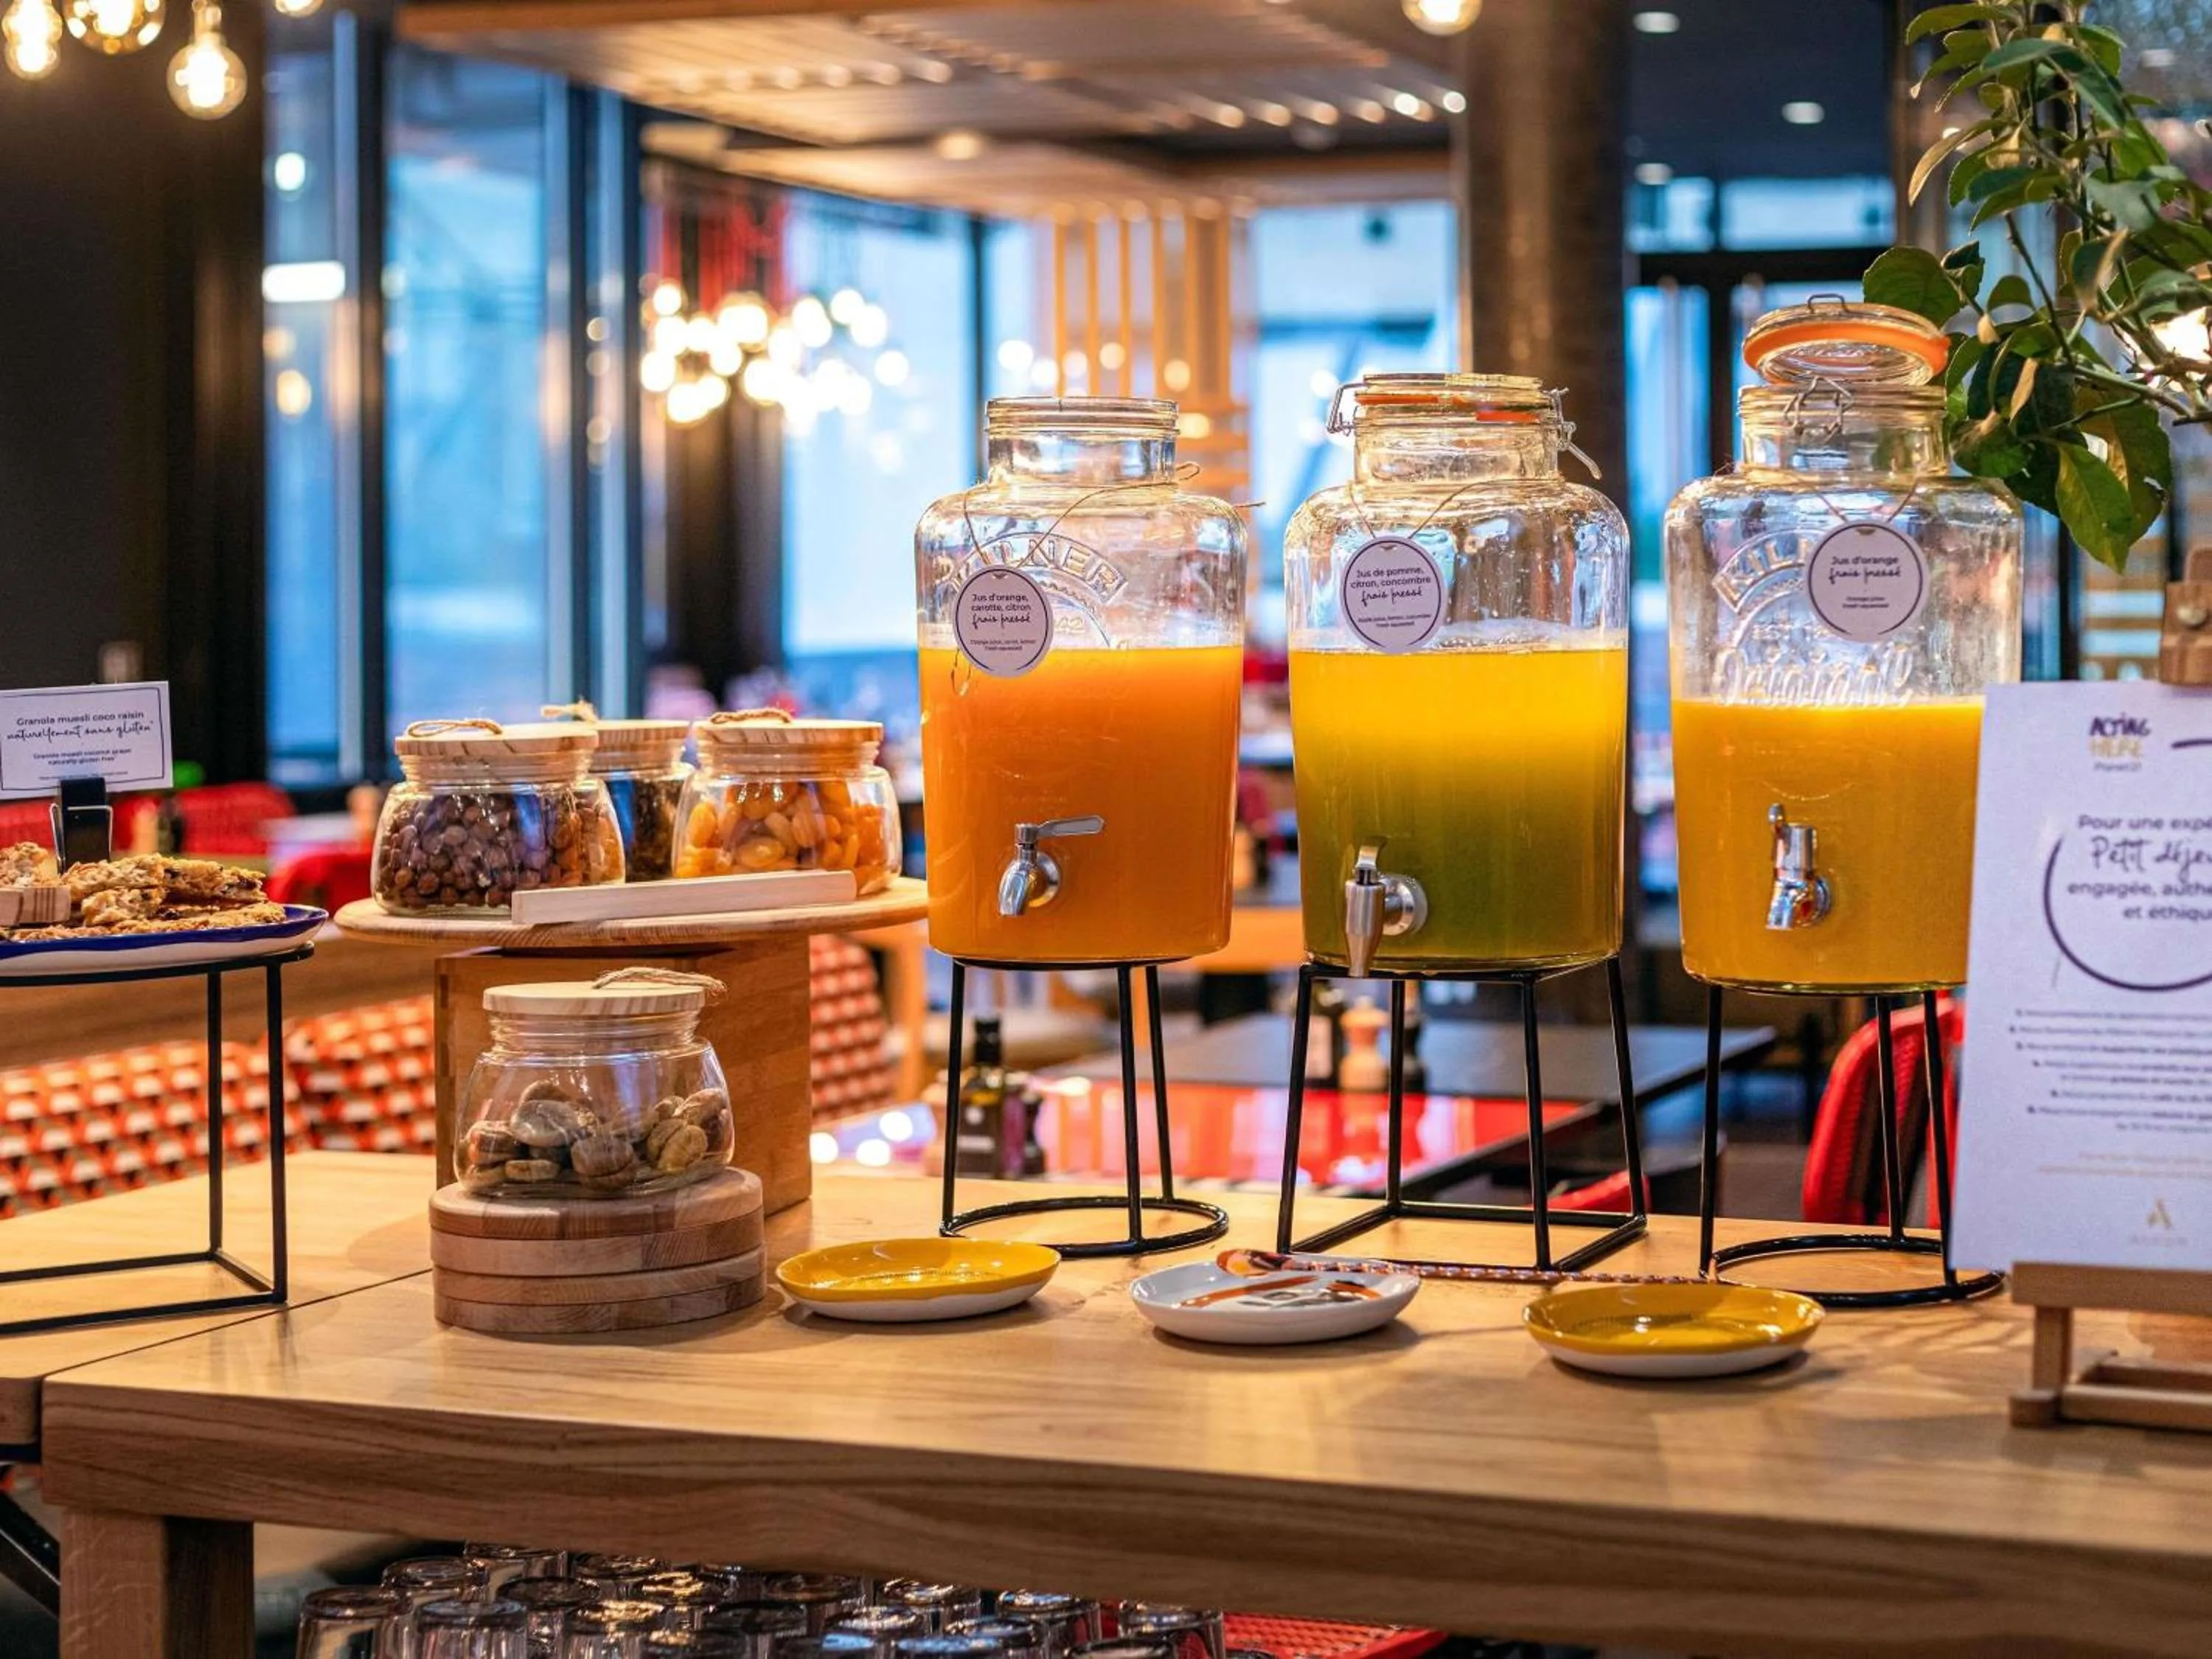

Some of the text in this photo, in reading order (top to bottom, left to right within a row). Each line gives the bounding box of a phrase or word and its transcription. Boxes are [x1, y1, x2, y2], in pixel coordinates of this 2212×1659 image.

[1831, 556, 1899, 566] Jus d'orange
[1357, 570, 1371, 578] Jus
[1372, 568, 1384, 577] de
[1829, 567, 1860, 585] frais
[1380, 577, 1431, 587] concombre
[972, 594, 987, 602] Jus
[1361, 586, 1423, 607] frais pressé
[1005, 603, 1032, 611] citron
[972, 612, 1031, 630] frais pressé
[17, 711, 145, 726] Granola muesli coco raisin
[85, 726, 113, 735] sans
[2079, 815, 2122, 830] Pour
[2128, 818, 2165, 830] une
[2124, 907, 2141, 919] et
